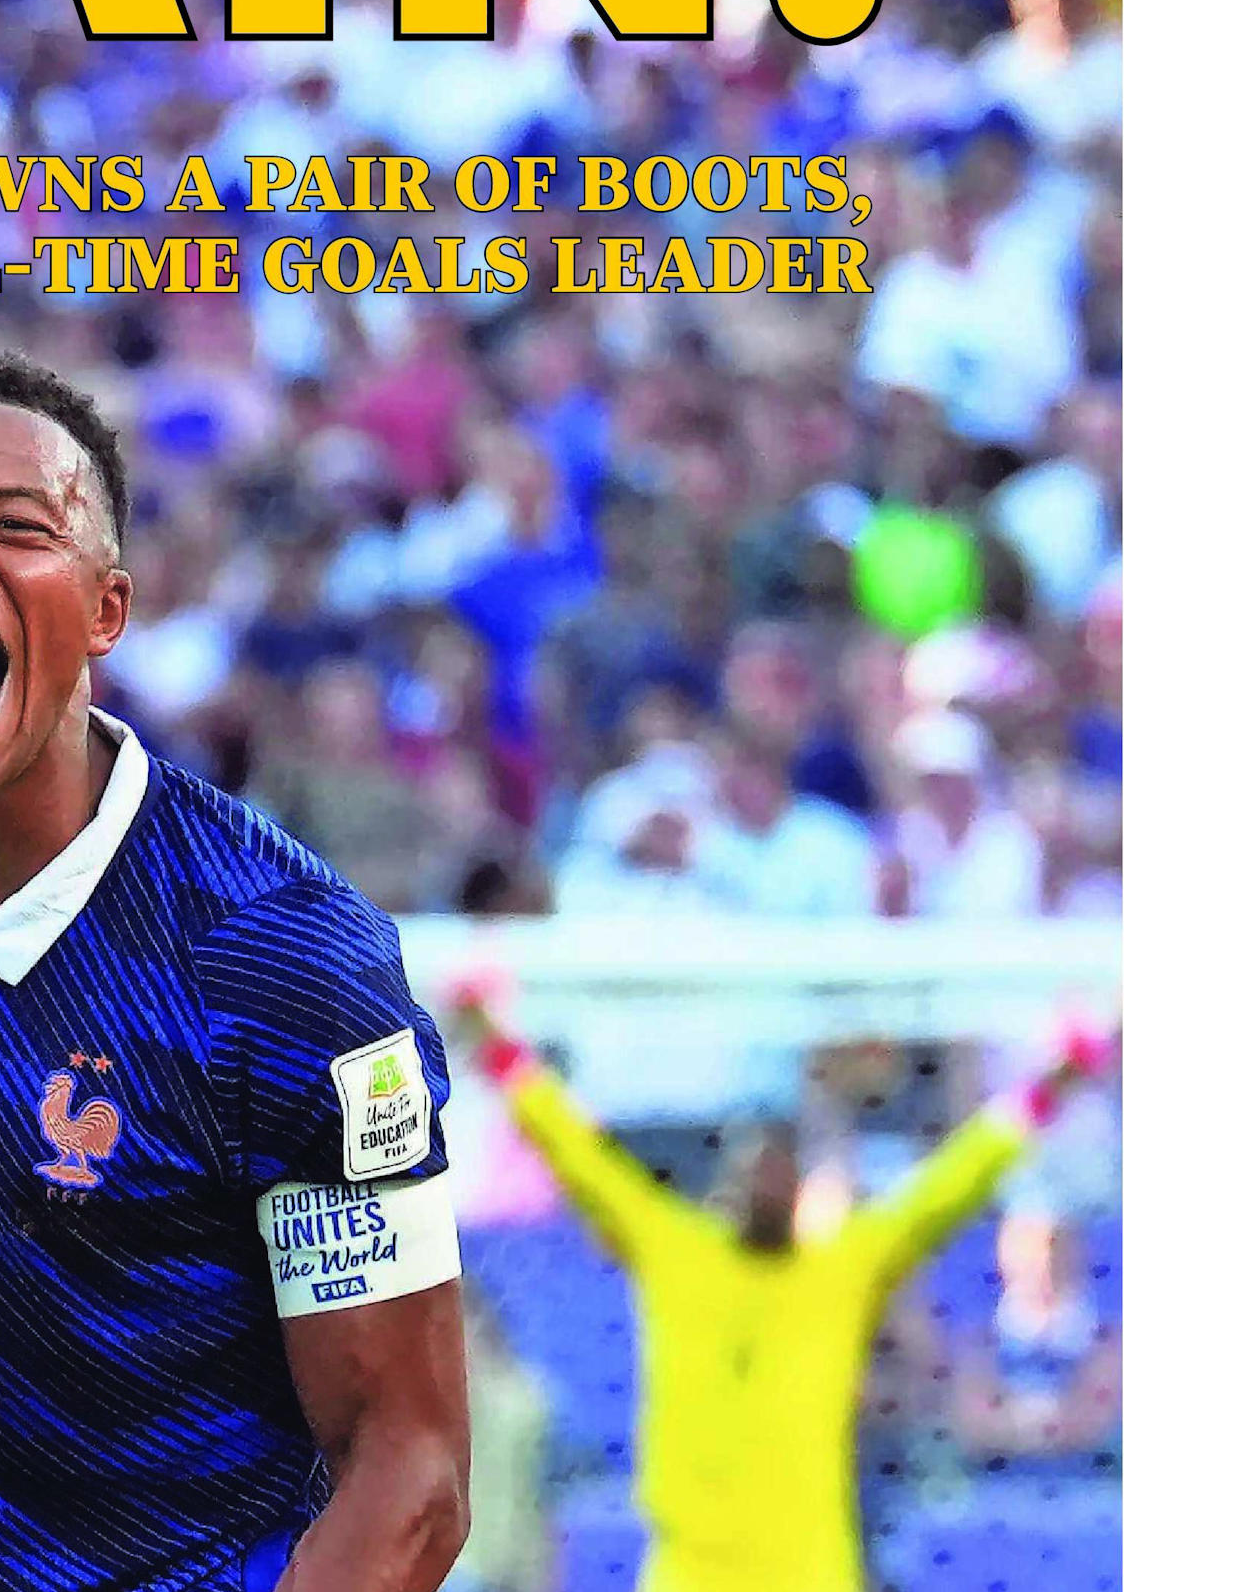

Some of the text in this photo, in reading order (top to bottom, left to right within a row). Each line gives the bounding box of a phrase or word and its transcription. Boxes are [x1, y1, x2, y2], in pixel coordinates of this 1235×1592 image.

[166, 155, 225, 212] A
[246, 155, 434, 212] PAIR
[454, 155, 557, 212] OF
[579, 155, 871, 225] BOOTS,
[263, 236, 529, 294] GOALS
[551, 236, 872, 294] LEADER
[360, 1112, 418, 1150] EDUCATION
[385, 1143, 408, 1158] FIFA
[272, 1182, 379, 1217] FOOTBALL
[274, 1201, 386, 1252] UNITES
[275, 1233, 397, 1283] the World
[316, 1278, 366, 1300] FIFA
